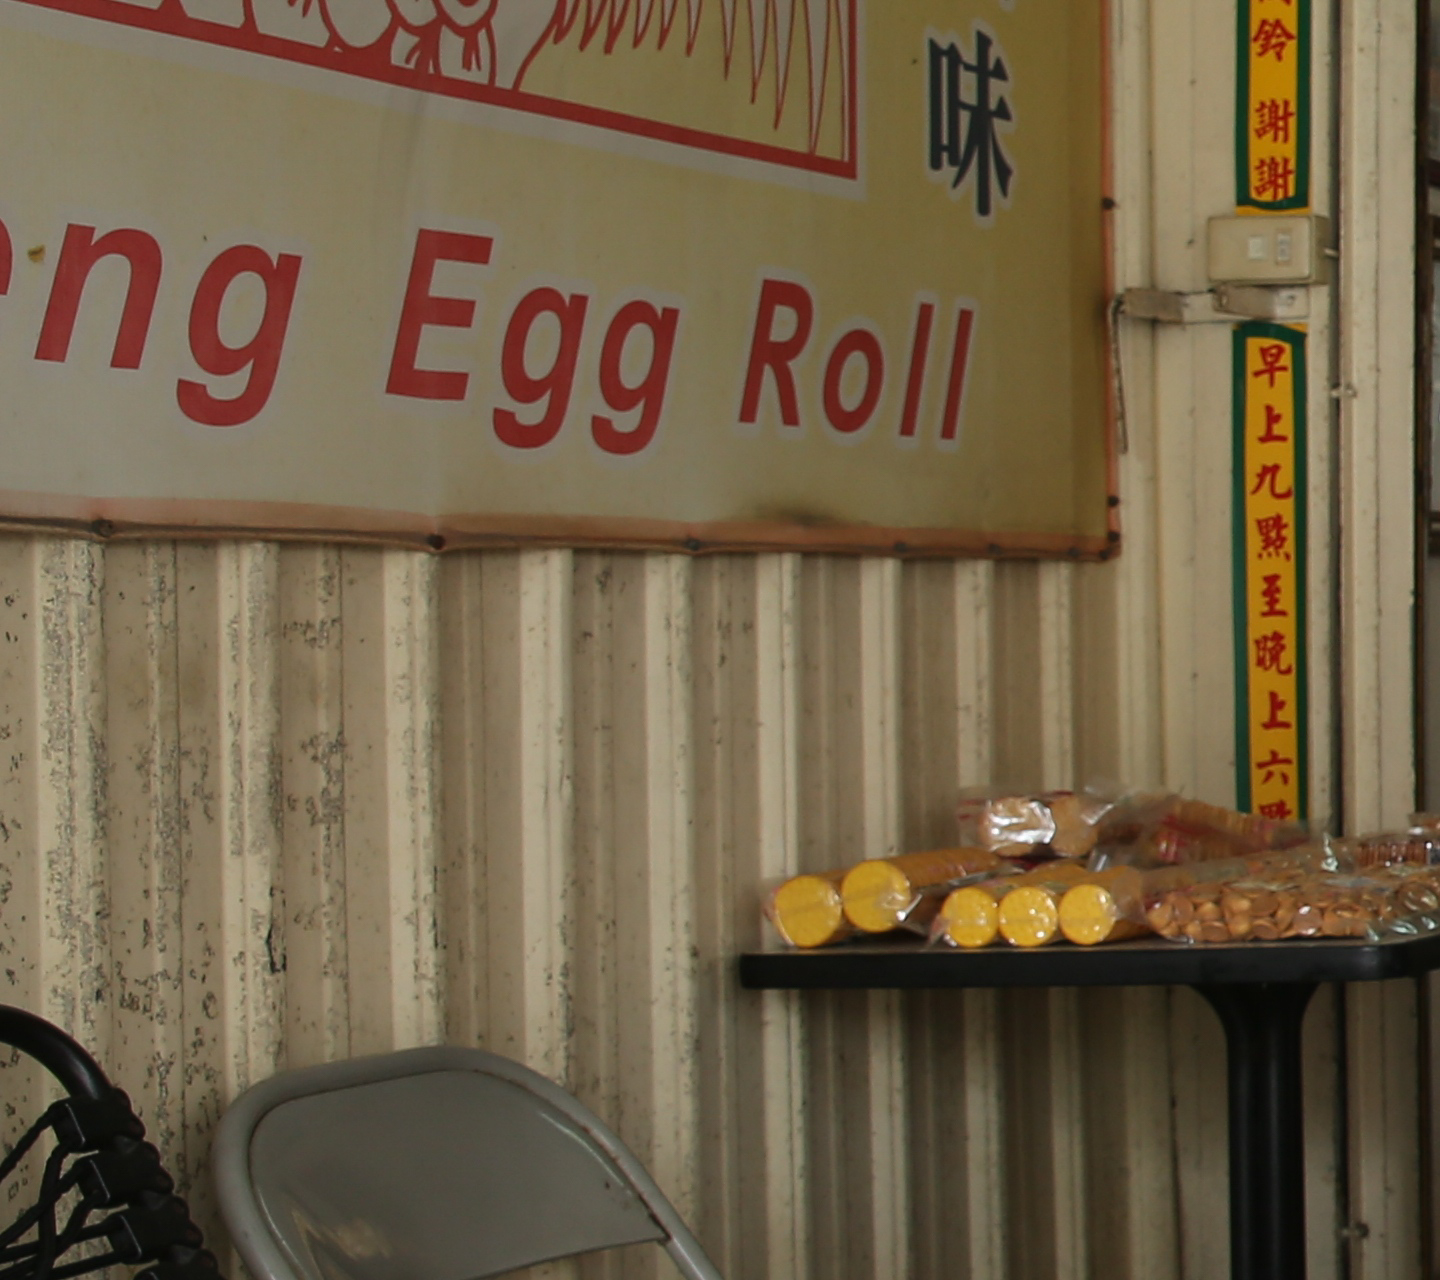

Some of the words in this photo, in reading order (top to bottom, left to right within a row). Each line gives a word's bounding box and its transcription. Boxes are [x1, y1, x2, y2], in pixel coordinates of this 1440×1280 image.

[1254, 98, 1296, 201] 謝謝
[0, 218, 302, 426] ng
[386, 228, 678, 454] Egg
[738, 278, 974, 441] Roll
